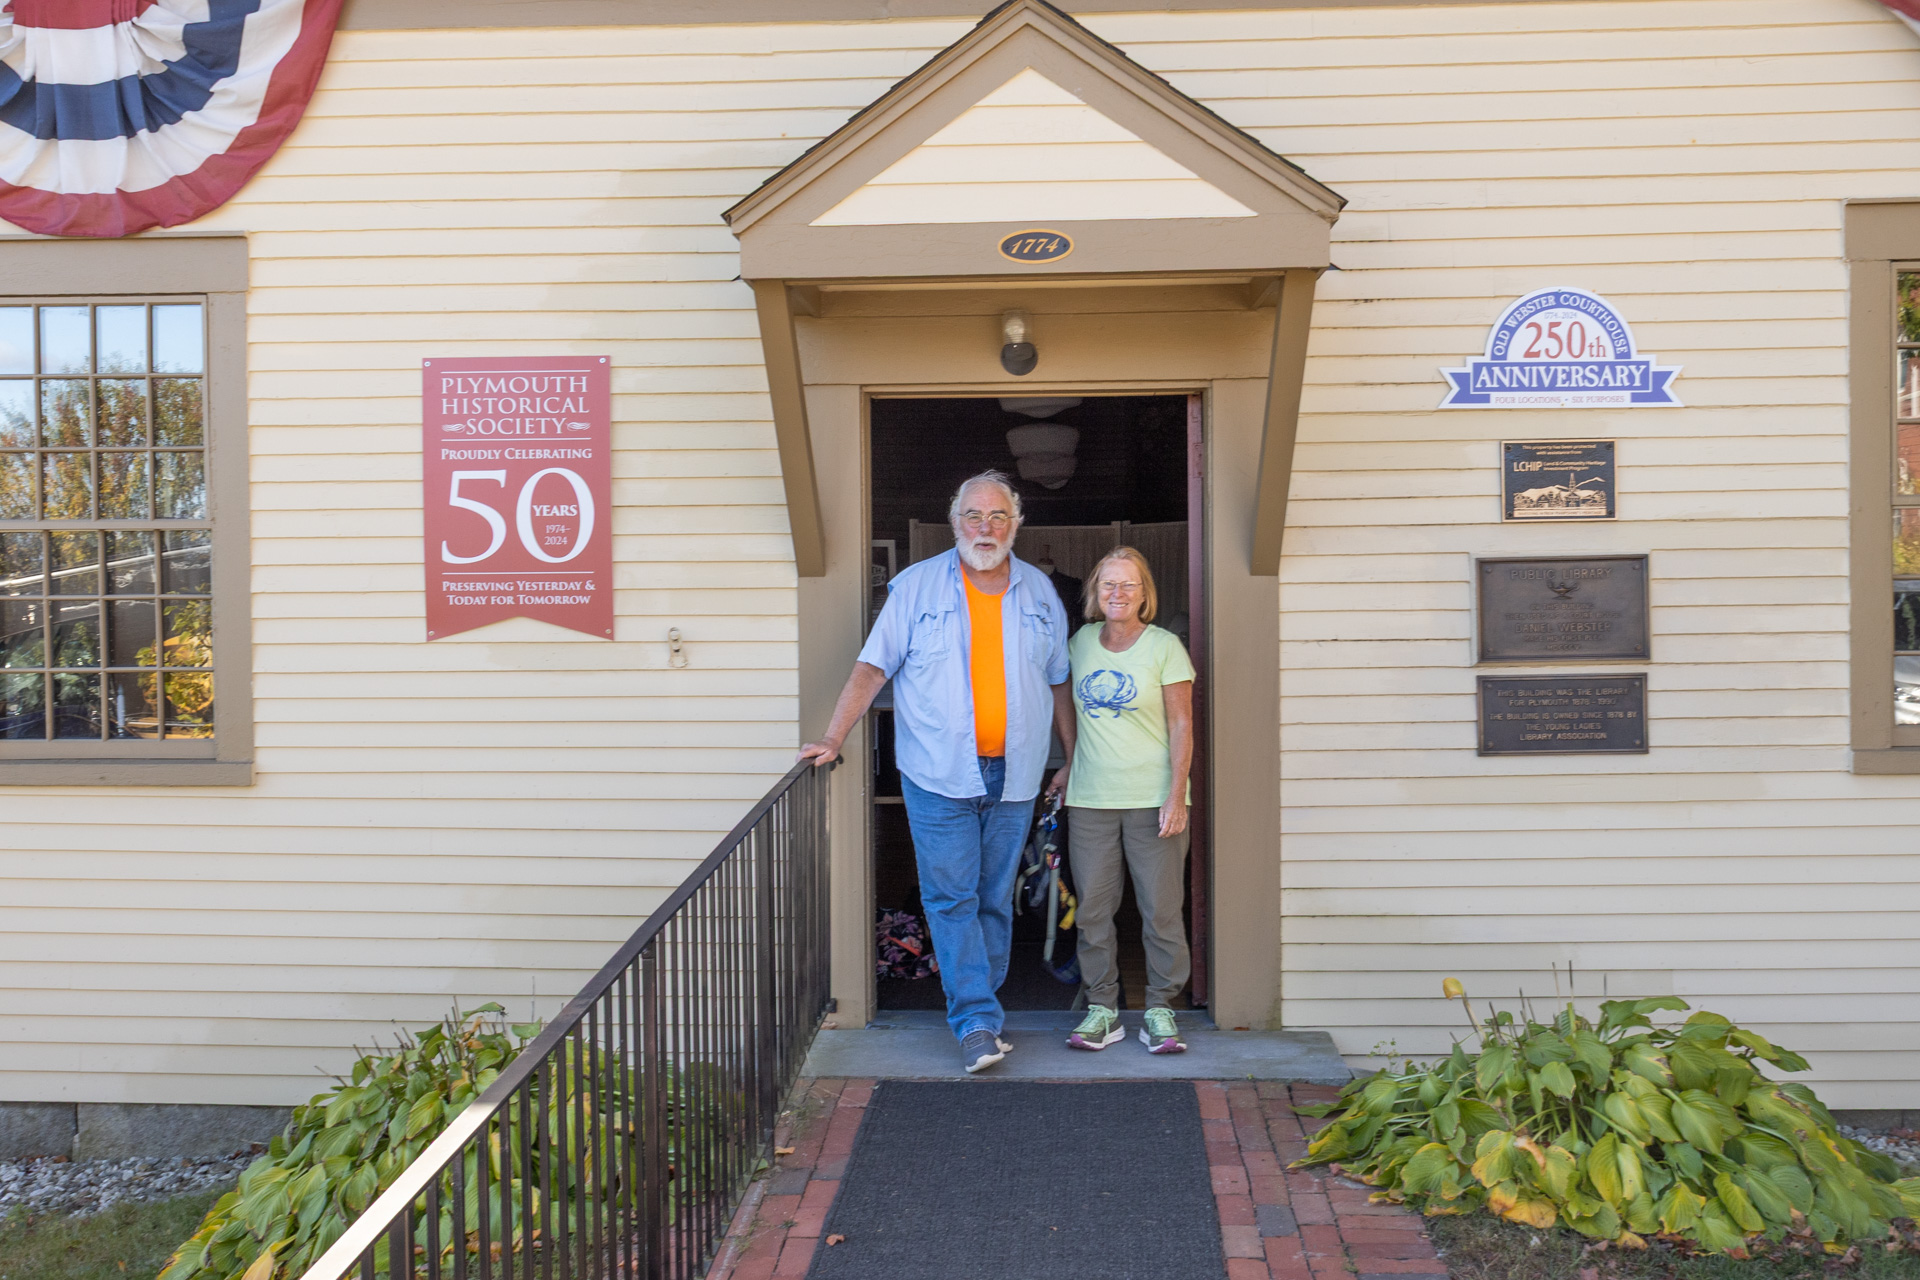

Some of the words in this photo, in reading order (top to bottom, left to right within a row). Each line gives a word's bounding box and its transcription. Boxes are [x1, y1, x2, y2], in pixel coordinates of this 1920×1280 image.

[1011, 237, 1060, 254] 1774
[1493, 330, 1510, 356] OLD
[1504, 295, 1557, 328] WEBSTER
[1559, 294, 1628, 355] COURTHOUSE
[1523, 321, 1607, 359] 250th
[1474, 364, 1647, 388] ANNIVERSARY
[441, 376, 588, 395] PLYMOUTH
[441, 397, 590, 415] HISTORICAL
[1494, 396, 1515, 404] FOUR
[1518, 396, 1561, 404] LOCATIONS
[465, 417, 567, 435] SOCIETY
[1513, 461, 1543, 472] LCHIP
[441, 467, 595, 564] 50
[532, 504, 578, 517] YEARS
[544, 536, 568, 545] 2024
[1510, 569, 1555, 580] PUBLIC
[1562, 568, 1612, 580] LIBRARY
[584, 579, 596, 591] &
[1515, 622, 1553, 633] DANIEL
[1558, 621, 1612, 632] WEBSTER
[1518, 689, 1554, 697] BUILDING
[1556, 688, 1574, 696] WAS
[1577, 688, 1592, 696] THE
[1596, 687, 1629, 695] LIBRARY
[1528, 698, 1569, 706] PLYMOUTH
[1506, 712, 1539, 720] BUILDING
[1582, 711, 1603, 719] SINCE
[1573, 722, 1602, 730] LADIES
[1519, 733, 1553, 741] LIBRARY
[1556, 732, 1607, 740] ASSOCIATION
